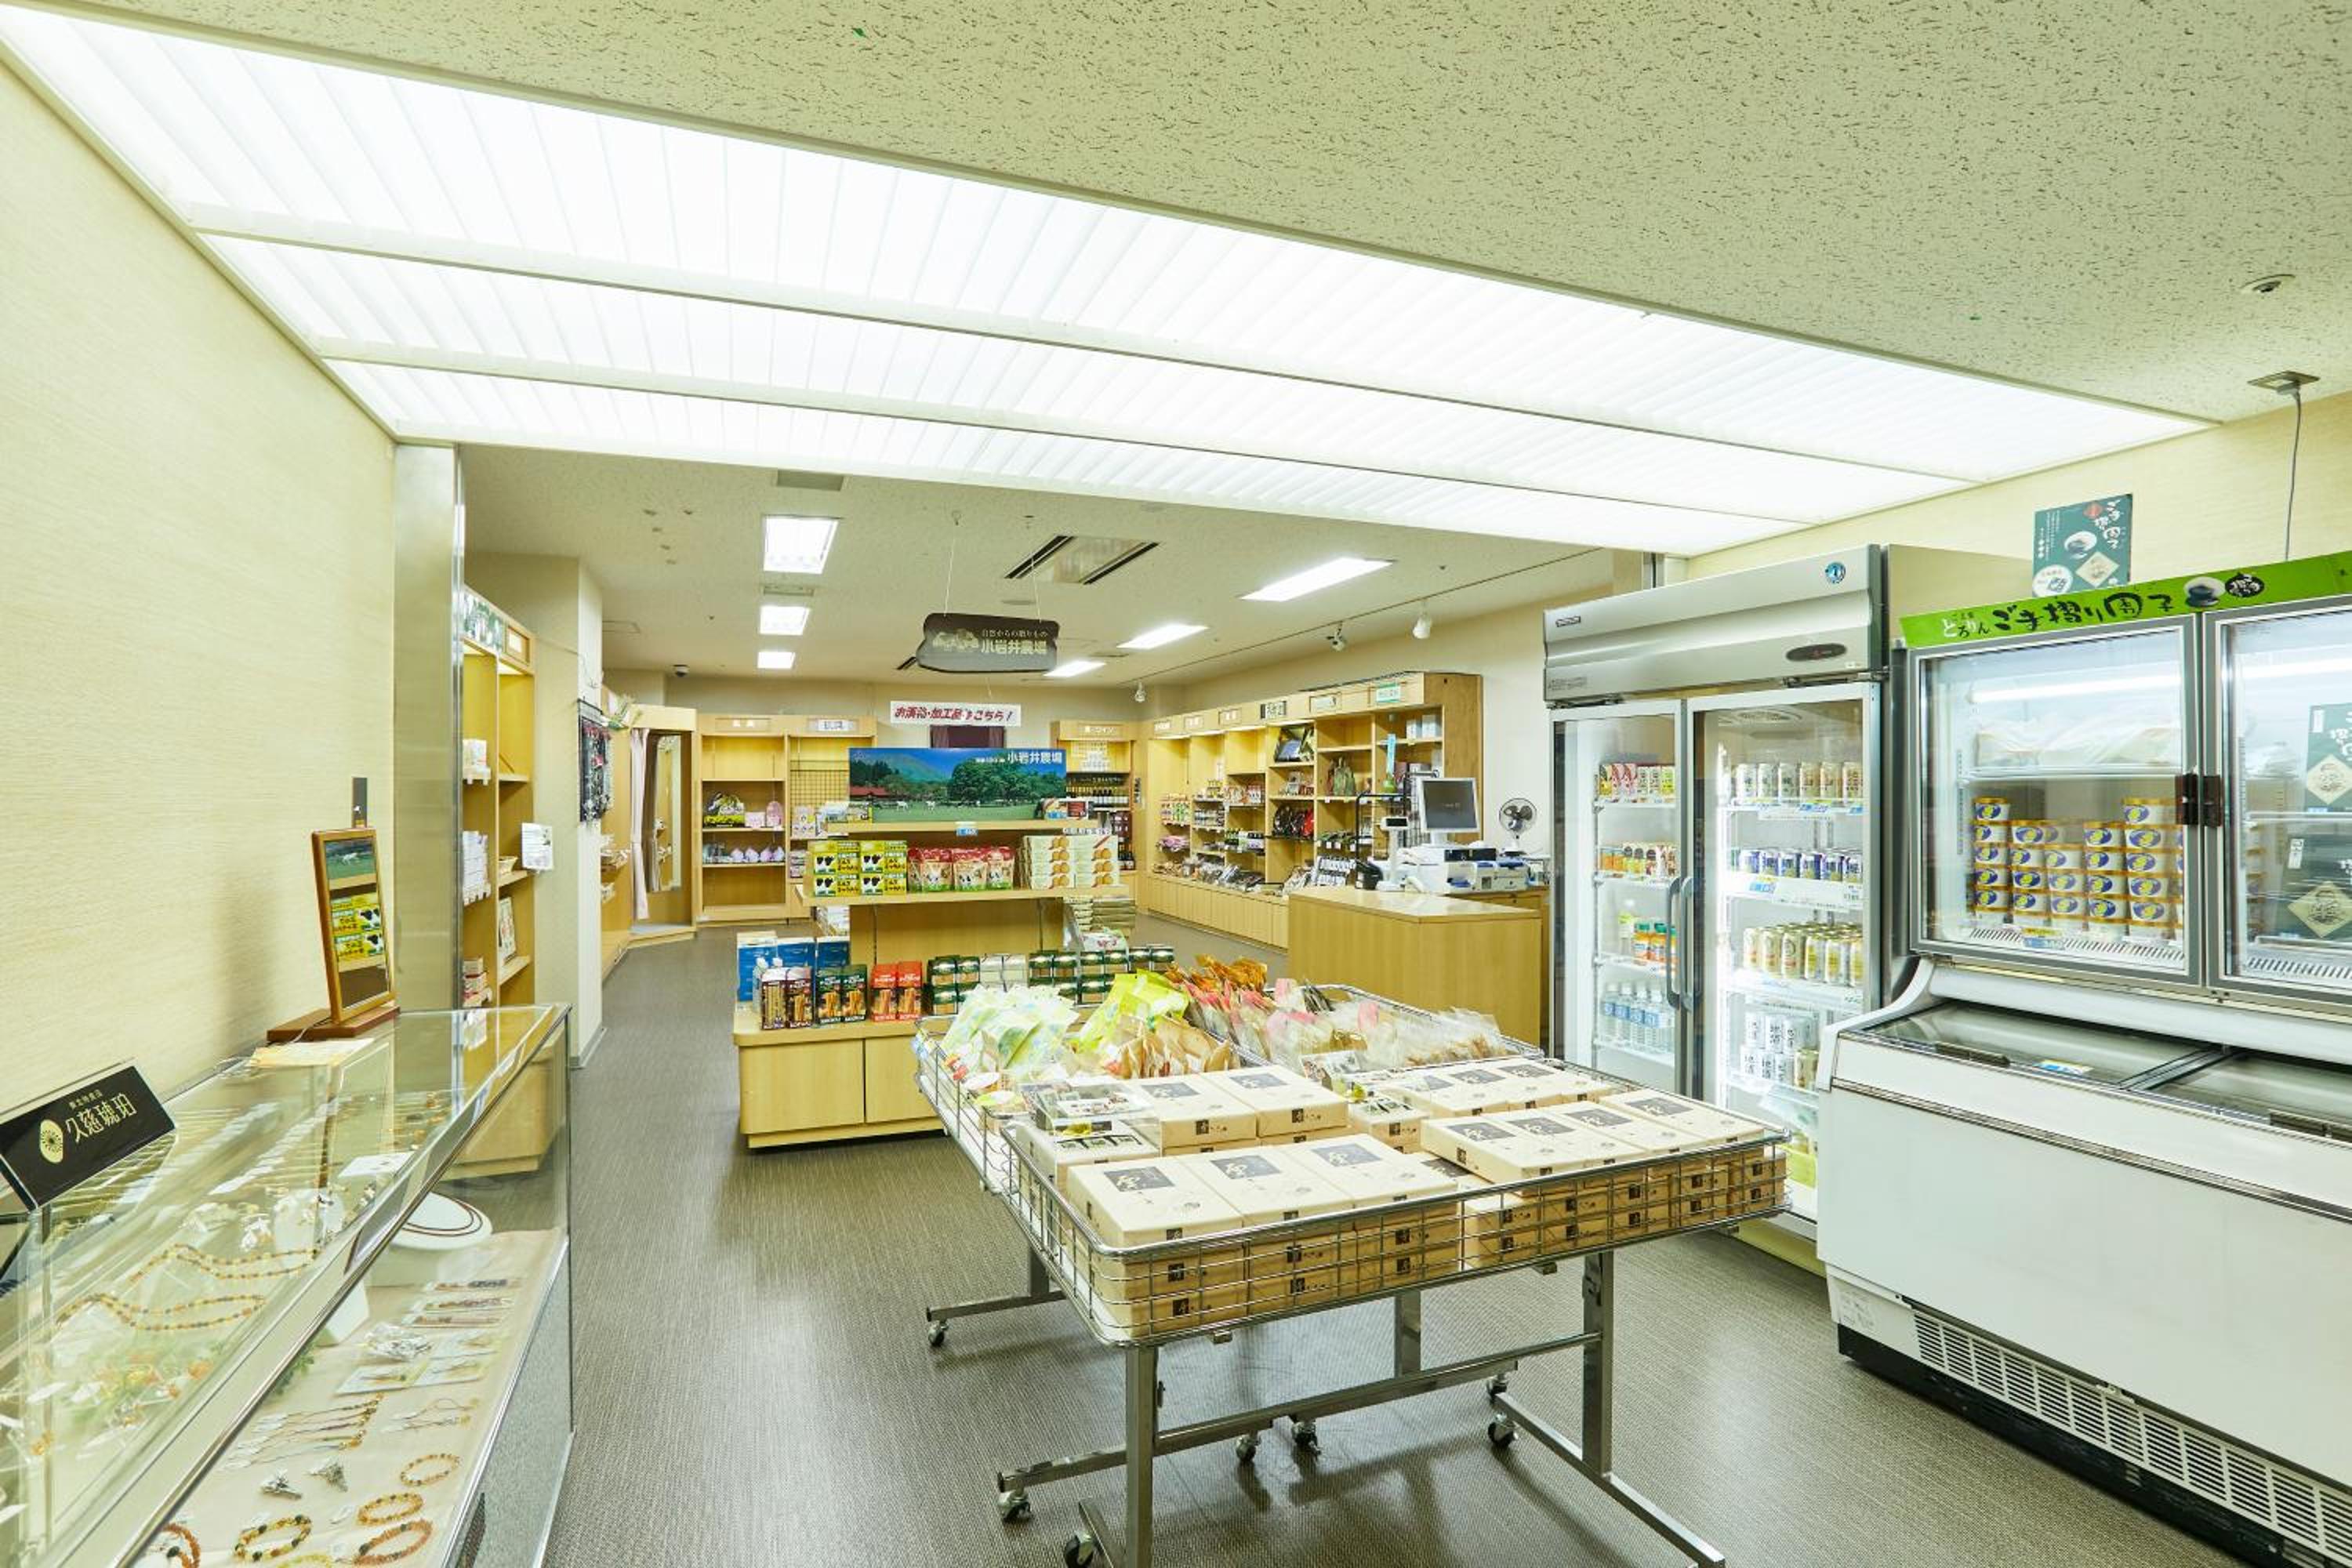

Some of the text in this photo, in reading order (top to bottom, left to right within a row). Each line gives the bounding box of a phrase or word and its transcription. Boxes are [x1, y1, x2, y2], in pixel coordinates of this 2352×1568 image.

[981, 639, 1047, 655] 小岩井農場
[65, 1092, 137, 1144] 久慈琥珀
